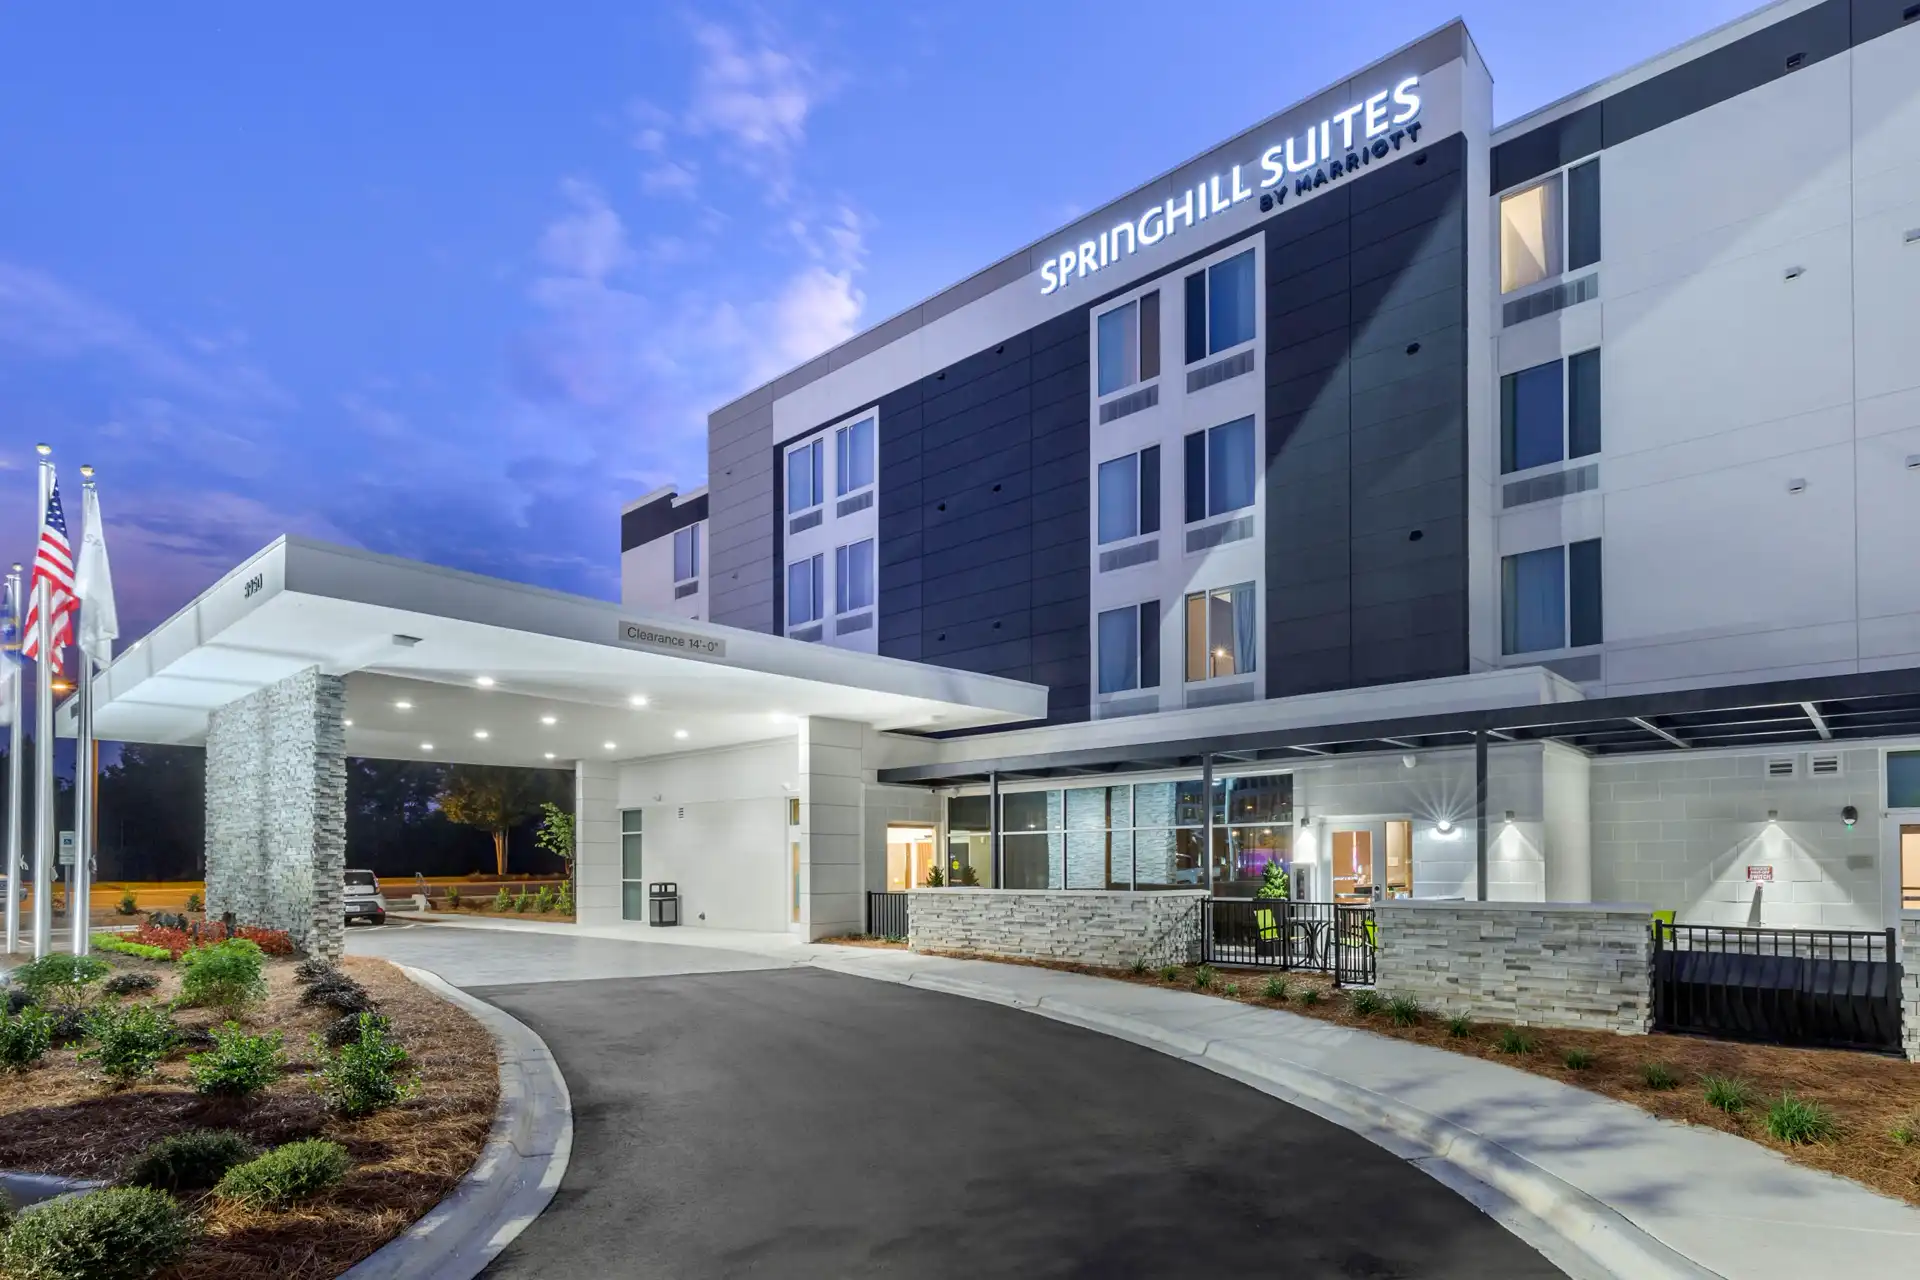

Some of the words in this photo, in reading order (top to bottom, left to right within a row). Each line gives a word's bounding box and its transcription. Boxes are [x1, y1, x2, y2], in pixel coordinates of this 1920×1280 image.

[1040, 165, 1253, 295] SPRINGHILL
[1259, 76, 1423, 188] SUITES
[1260, 186, 1288, 213] BY
[1295, 121, 1422, 196] MARRIOTT
[627, 626, 685, 646] Clearance
